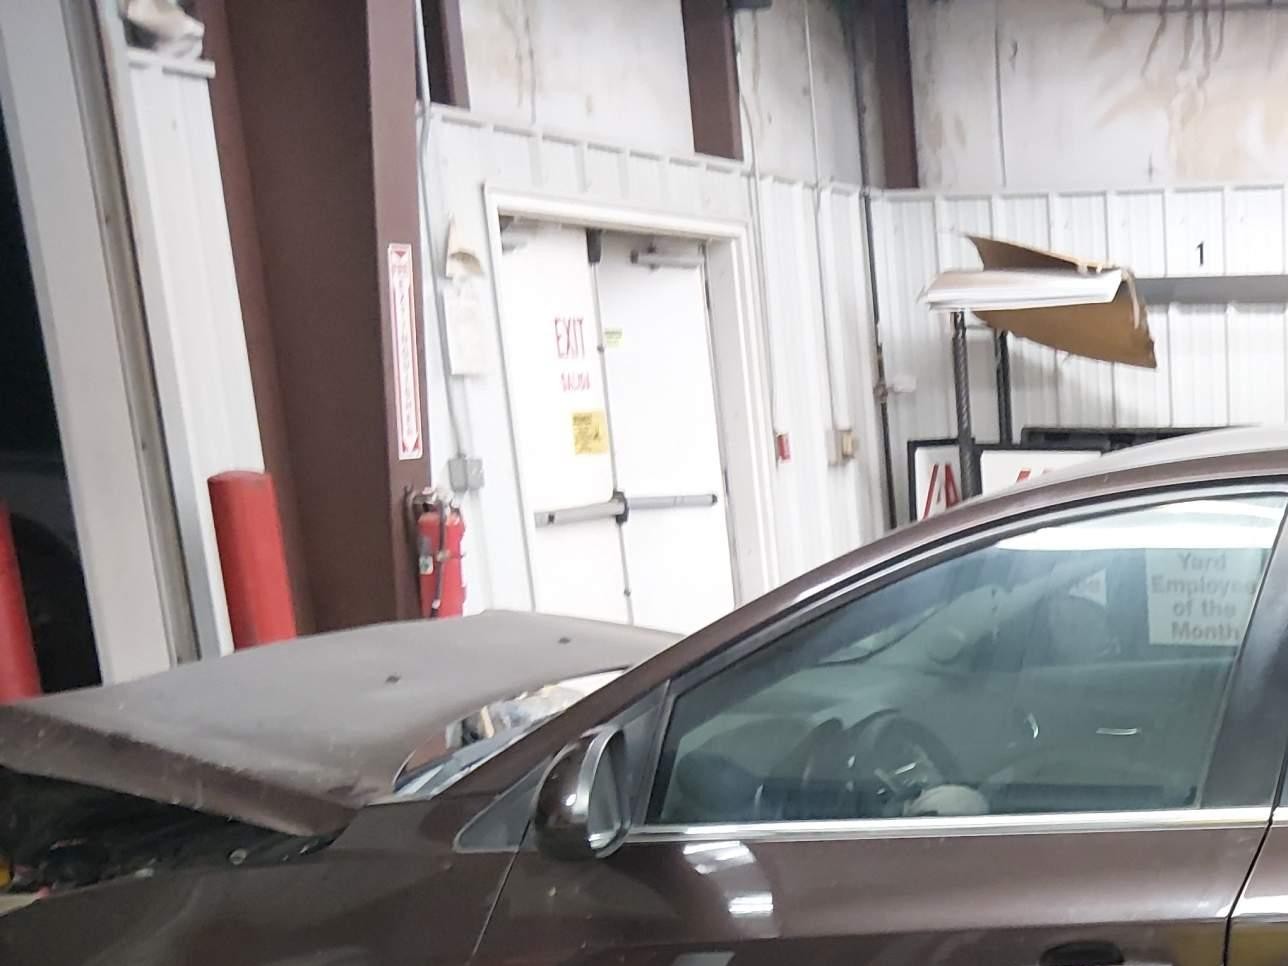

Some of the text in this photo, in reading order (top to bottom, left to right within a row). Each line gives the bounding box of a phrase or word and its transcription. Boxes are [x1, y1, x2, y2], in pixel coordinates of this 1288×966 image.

[1196, 241, 1204, 267] 1
[554, 317, 585, 359] EXIT
[1178, 551, 1227, 571] Yard
[1173, 600, 1236, 617] of the
[1171, 621, 1240, 641] Month
